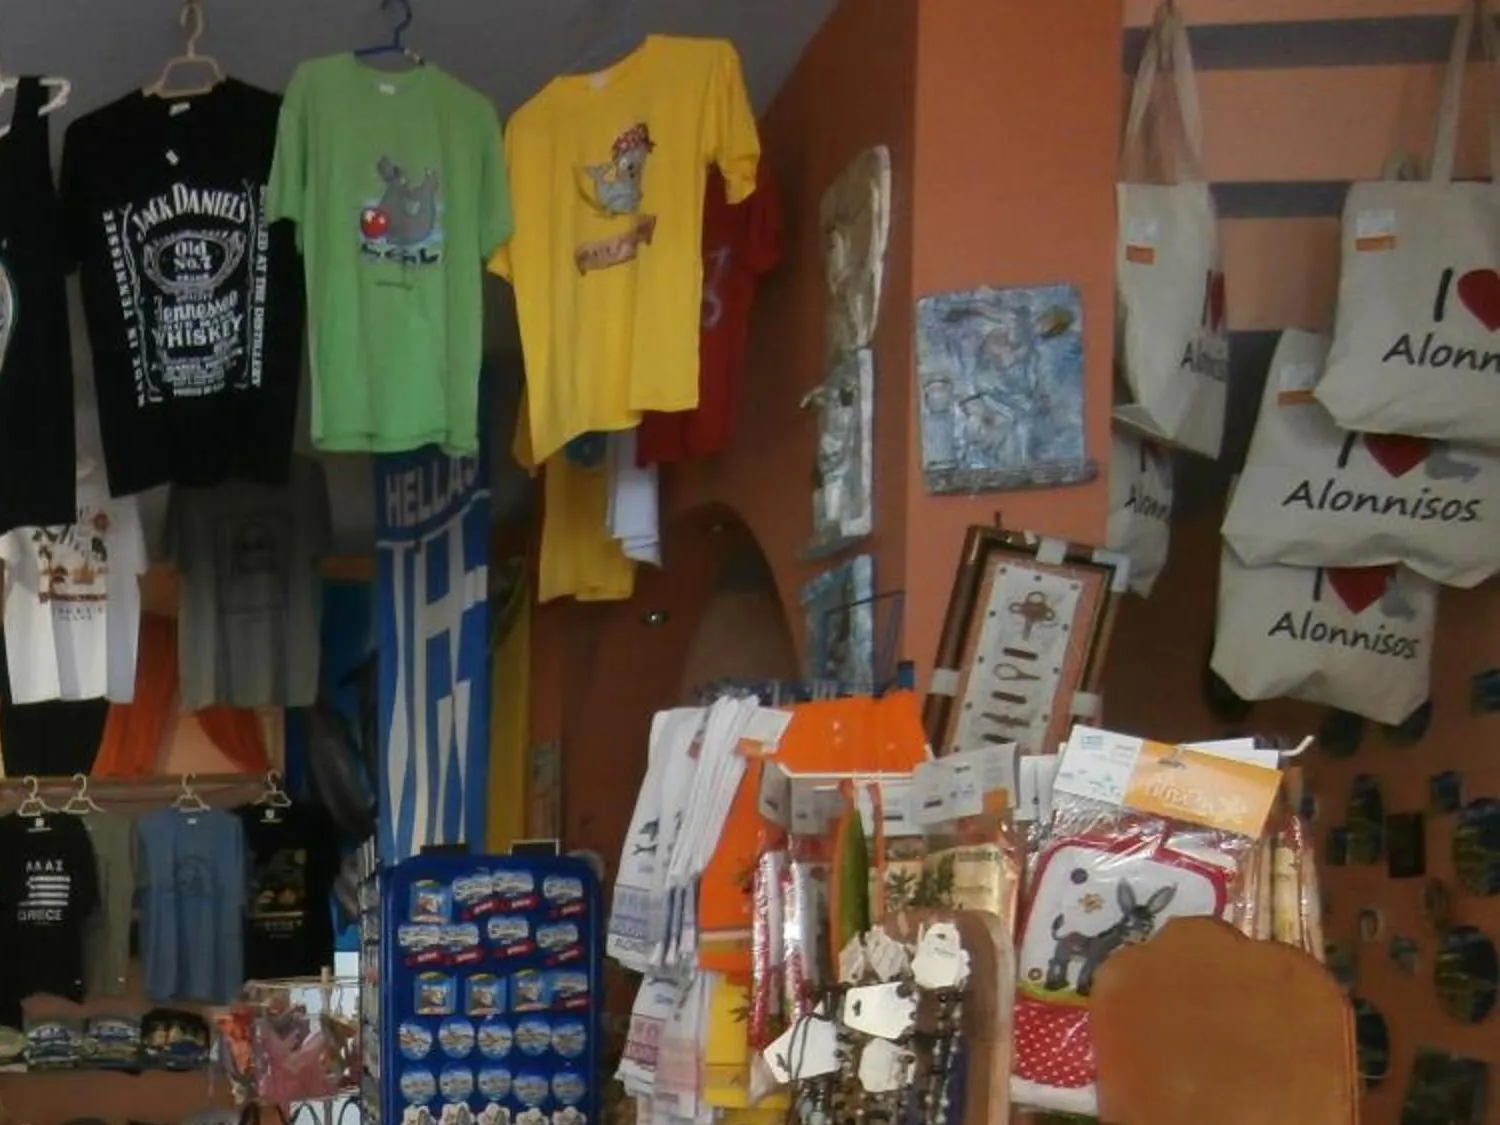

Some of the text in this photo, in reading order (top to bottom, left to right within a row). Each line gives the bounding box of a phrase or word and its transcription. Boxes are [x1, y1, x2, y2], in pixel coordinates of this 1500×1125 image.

[132, 196, 174, 241] JACK
[1433, 266, 1454, 323] I
[152, 314, 244, 348] WHISKEY
[1281, 477, 1483, 522] Alonnisos
[1267, 610, 1420, 659] Alonnisos
